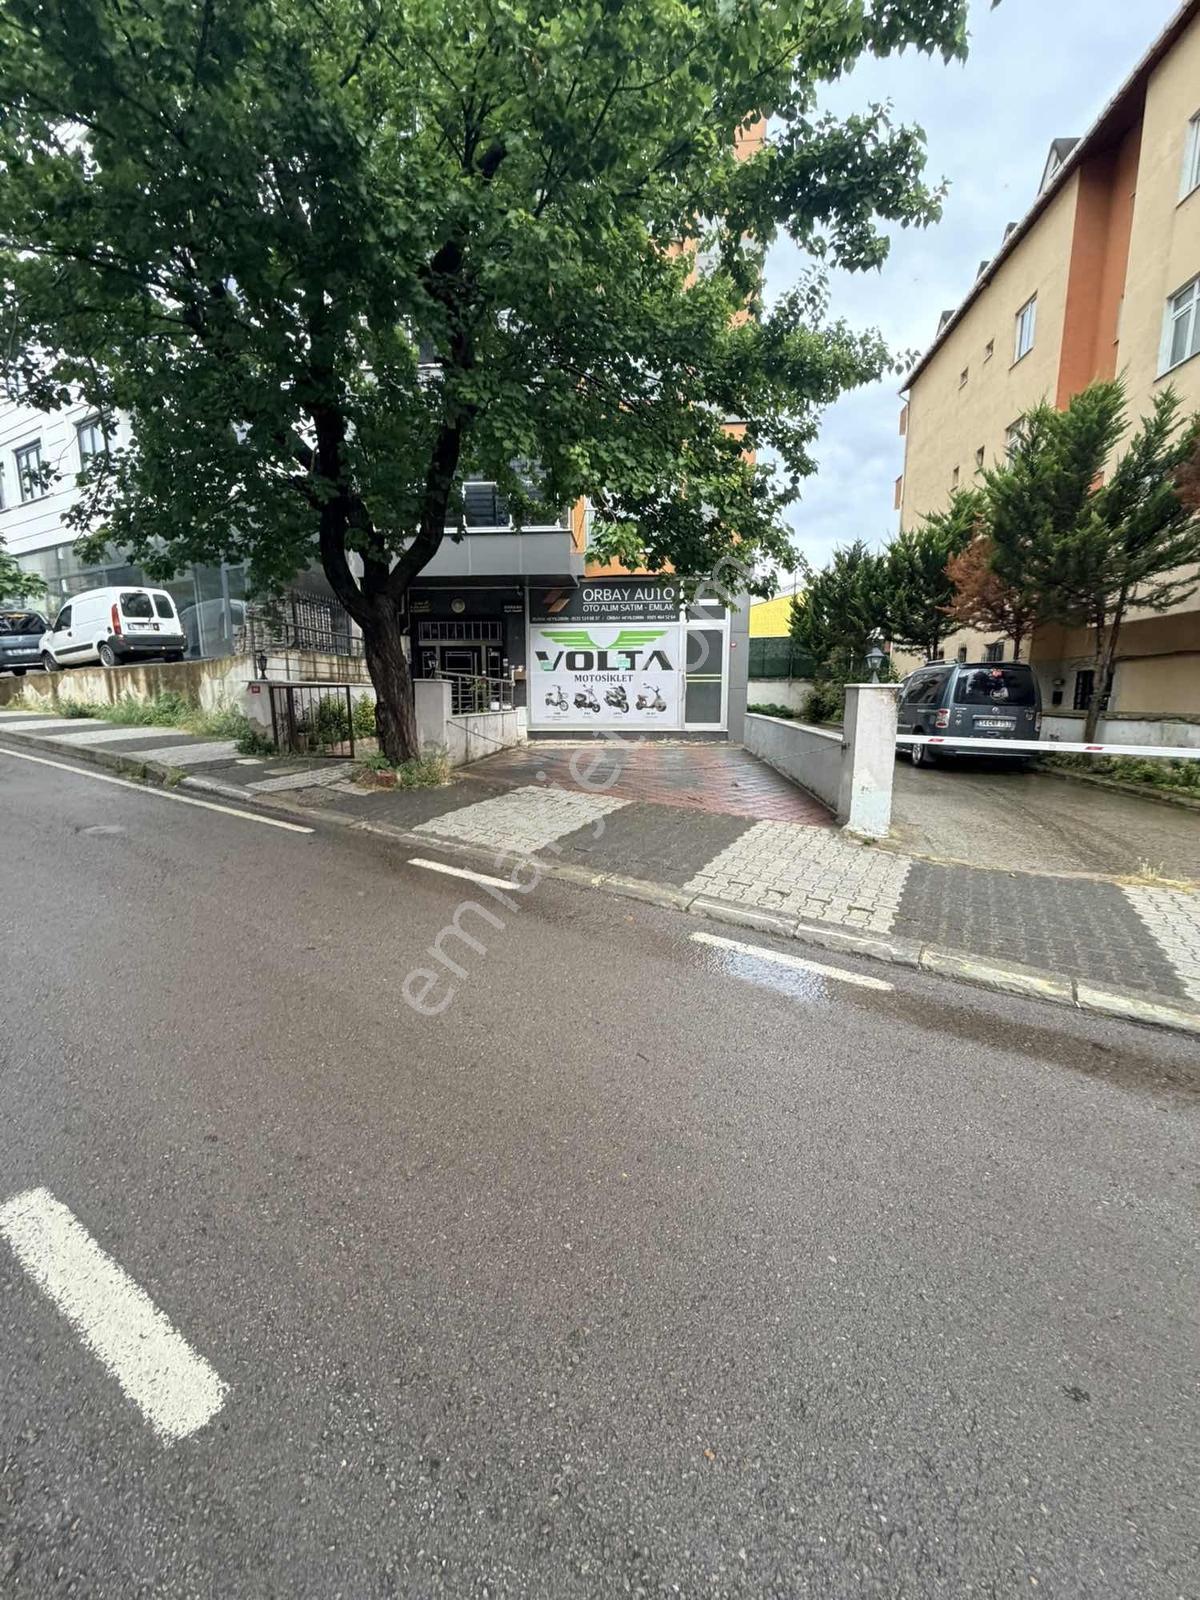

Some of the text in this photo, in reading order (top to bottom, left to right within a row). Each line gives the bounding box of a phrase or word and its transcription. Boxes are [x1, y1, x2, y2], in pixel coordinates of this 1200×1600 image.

[582, 588, 631, 602] ORBAY
[582, 603, 674, 612] OTO ALIM SATIM EMLAK
[535, 650, 674, 671] VOLTA
[574, 673, 634, 683] MOTOSİKLET
